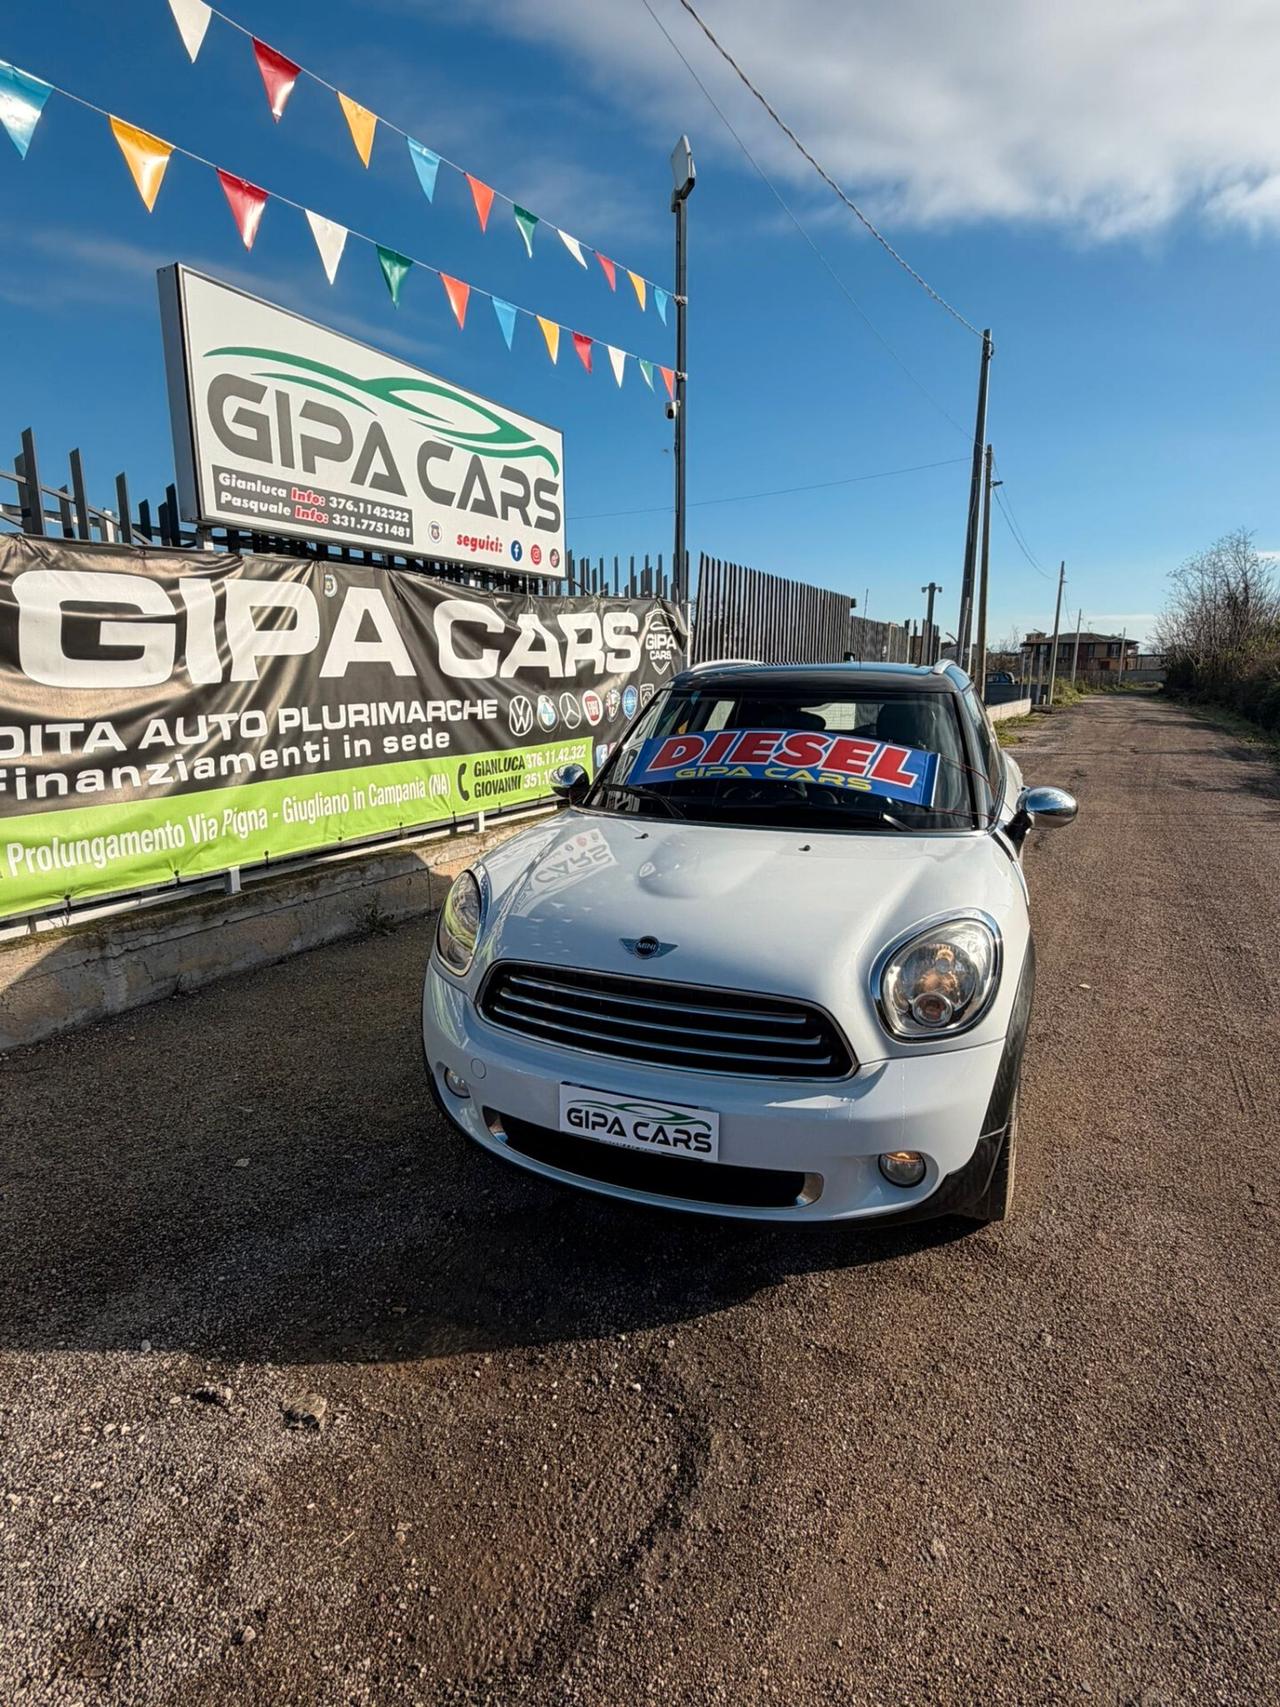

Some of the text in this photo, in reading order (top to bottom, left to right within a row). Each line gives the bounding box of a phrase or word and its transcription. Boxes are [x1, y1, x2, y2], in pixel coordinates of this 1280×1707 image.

[207, 373, 561, 534] GIPA CARS
[219, 472, 409, 523] Gianluca Info: 376.1142322
[220, 491, 410, 538] Pasquale Info: 331.7751481
[457, 534, 503, 552] seguici:
[11, 570, 641, 689] GIPA CARS
[645, 634, 677, 650] GIPA
[650, 651, 672, 661] CARS
[138, 709, 268, 750] AUTO
[278, 700, 498, 734] PLURIMARCHE
[343, 735, 372, 758] in
[383, 728, 450, 754] sede
[474, 755, 525, 777] GIANLUCA
[646, 730, 919, 788] DIESEL
[675, 766, 872, 791] GIPA CARS
[474, 775, 522, 798] GIOVANNI
[6, 823, 186, 877] Prolungamento
[187, 813, 218, 844] Via
[282, 792, 350, 825] Giugliano
[352, 786, 366, 810] in
[368, 776, 426, 806] Campania
[429, 773, 450, 800] (NA)
[567, 1107, 627, 1137] GIPA
[633, 1121, 712, 1153] CARS
